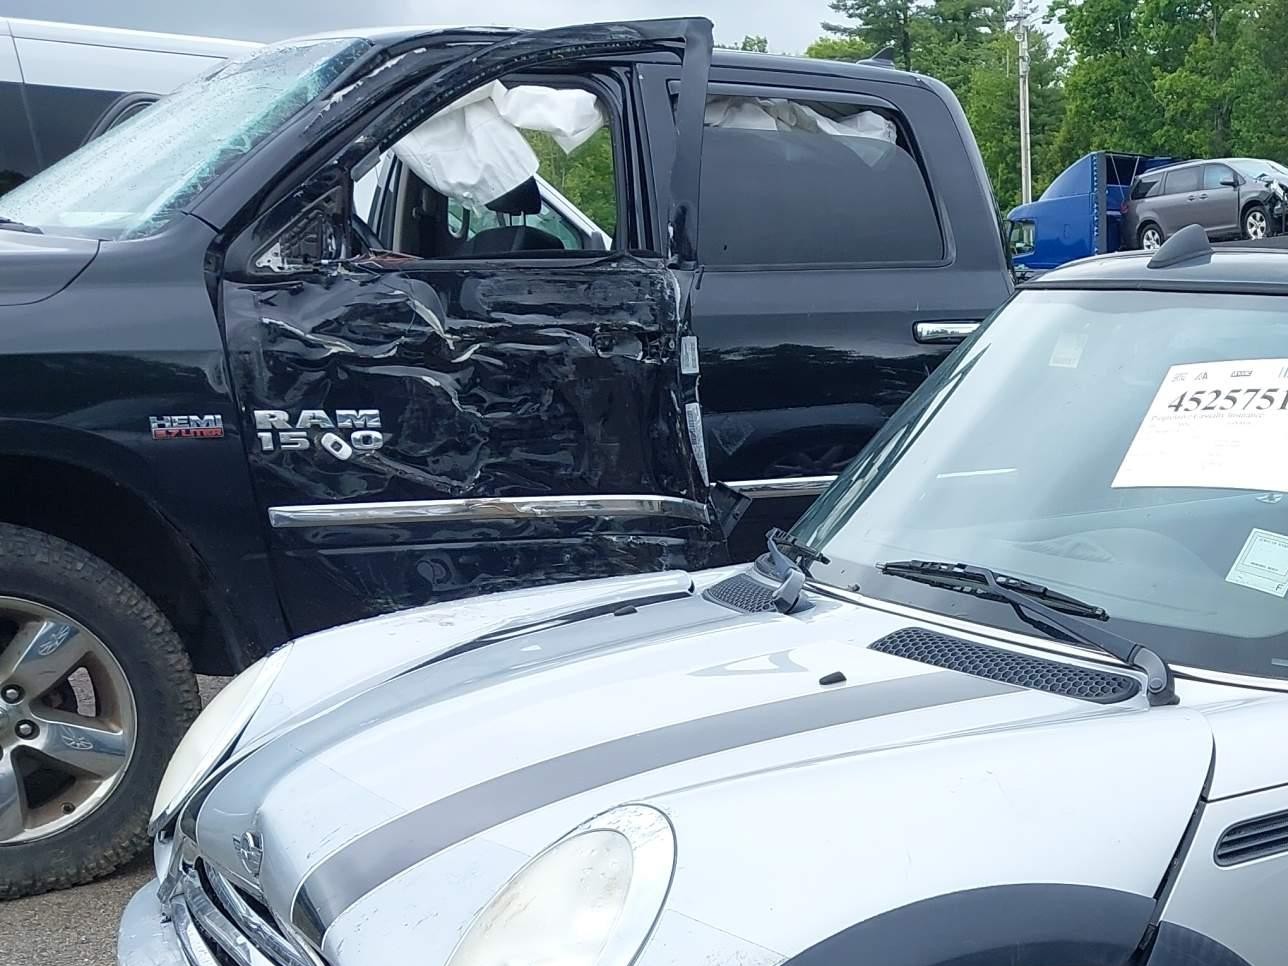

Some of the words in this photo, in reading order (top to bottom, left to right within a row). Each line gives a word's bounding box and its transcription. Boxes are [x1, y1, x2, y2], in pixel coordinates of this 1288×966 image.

[149, 414, 222, 429] HEMI
[253, 409, 382, 430] RAM
[256, 430, 384, 461] 1500
